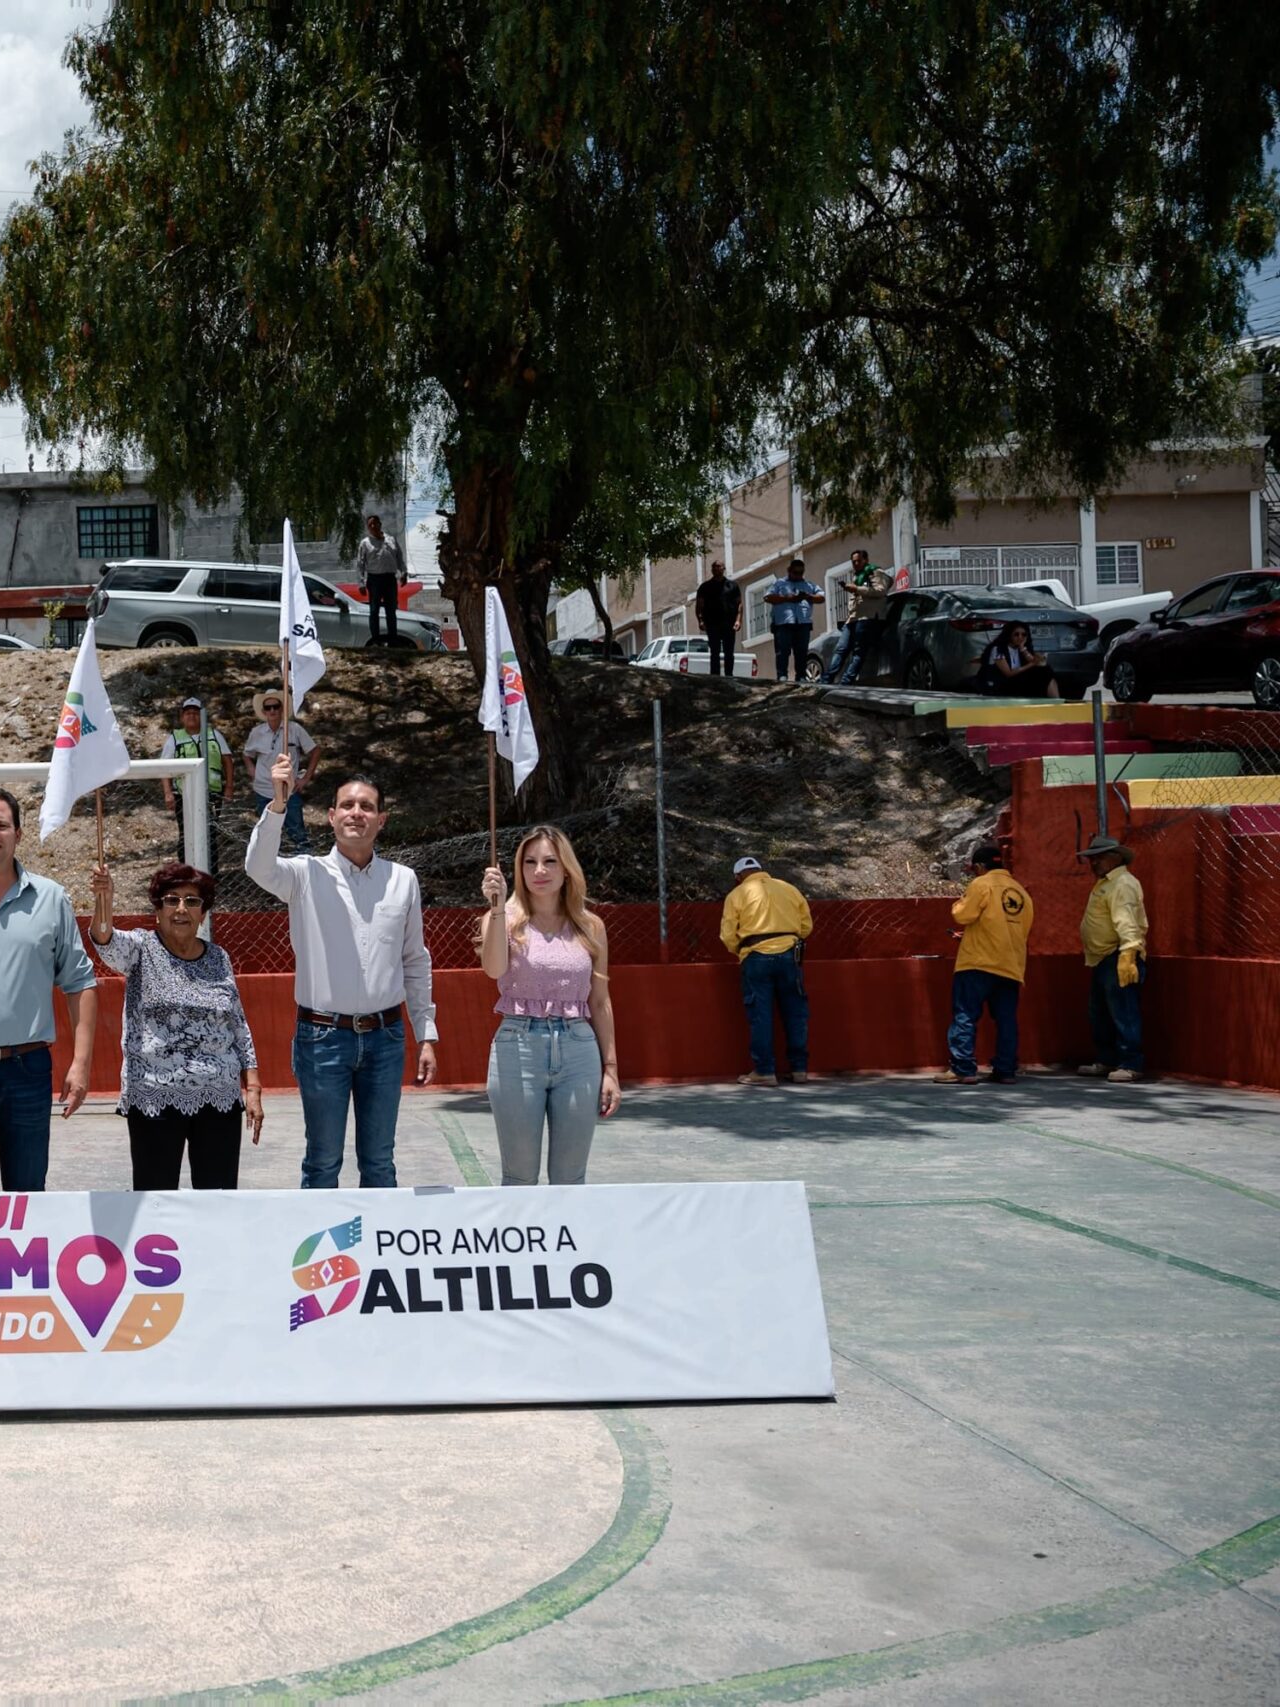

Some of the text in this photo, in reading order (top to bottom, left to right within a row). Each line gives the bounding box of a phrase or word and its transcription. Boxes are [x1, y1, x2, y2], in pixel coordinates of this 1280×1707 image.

[376, 1225, 578, 1256] POR AMOR A
